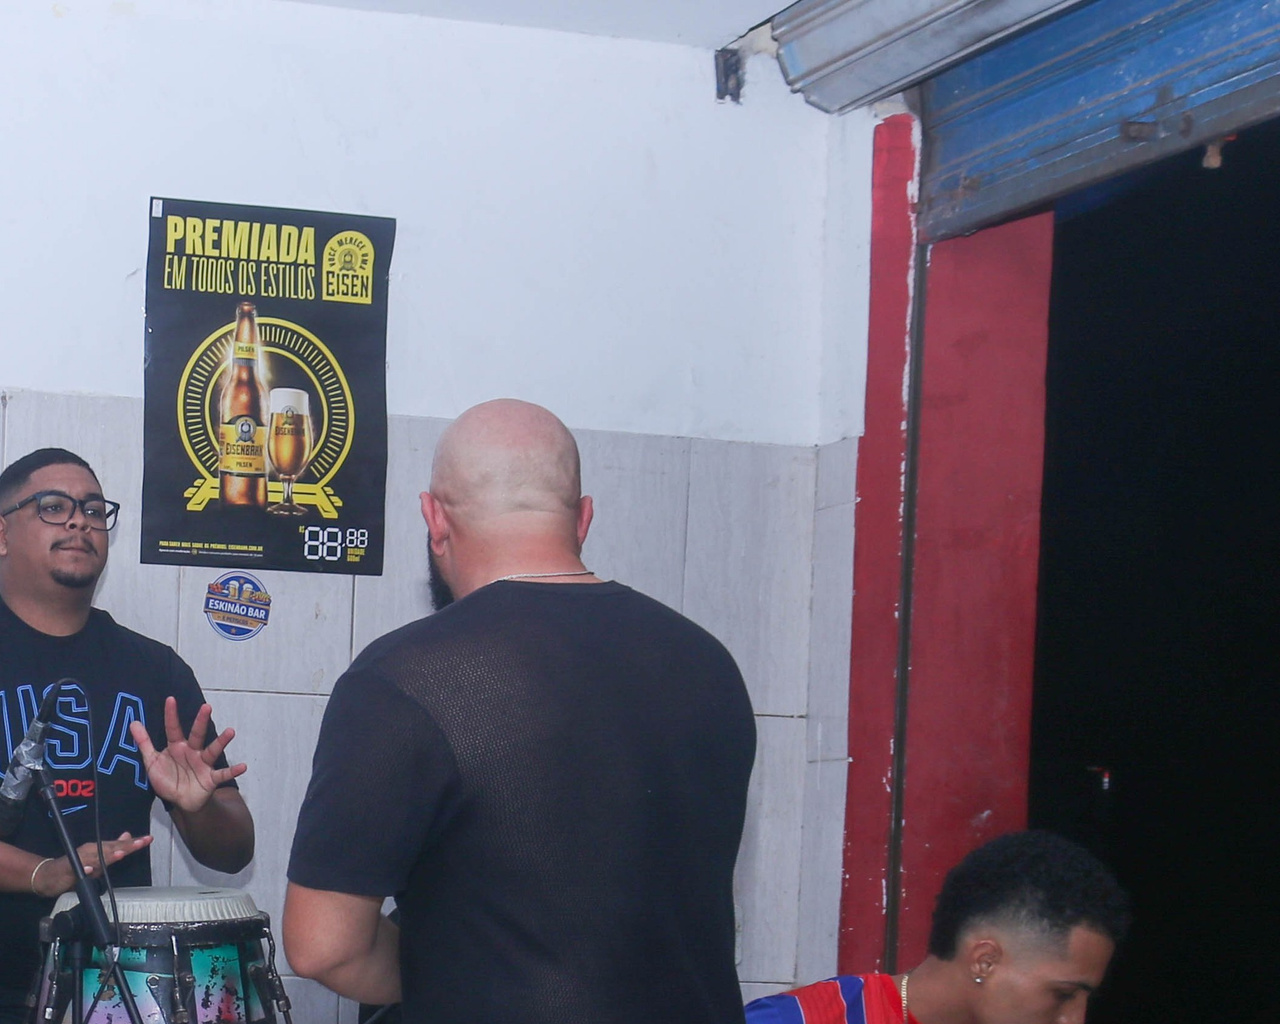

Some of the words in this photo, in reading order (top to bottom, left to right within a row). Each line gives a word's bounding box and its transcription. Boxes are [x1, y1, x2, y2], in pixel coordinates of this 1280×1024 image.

[166, 215, 315, 265] PREMIADA
[164, 254, 187, 290] EM
[191, 257, 234, 294] TODOS
[239, 260, 256, 296] OS
[261, 263, 315, 300] ESTILOS
[326, 270, 369, 298] EISEN
[247, 607, 266, 620] BAR
[52, 779, 95, 797] 002
